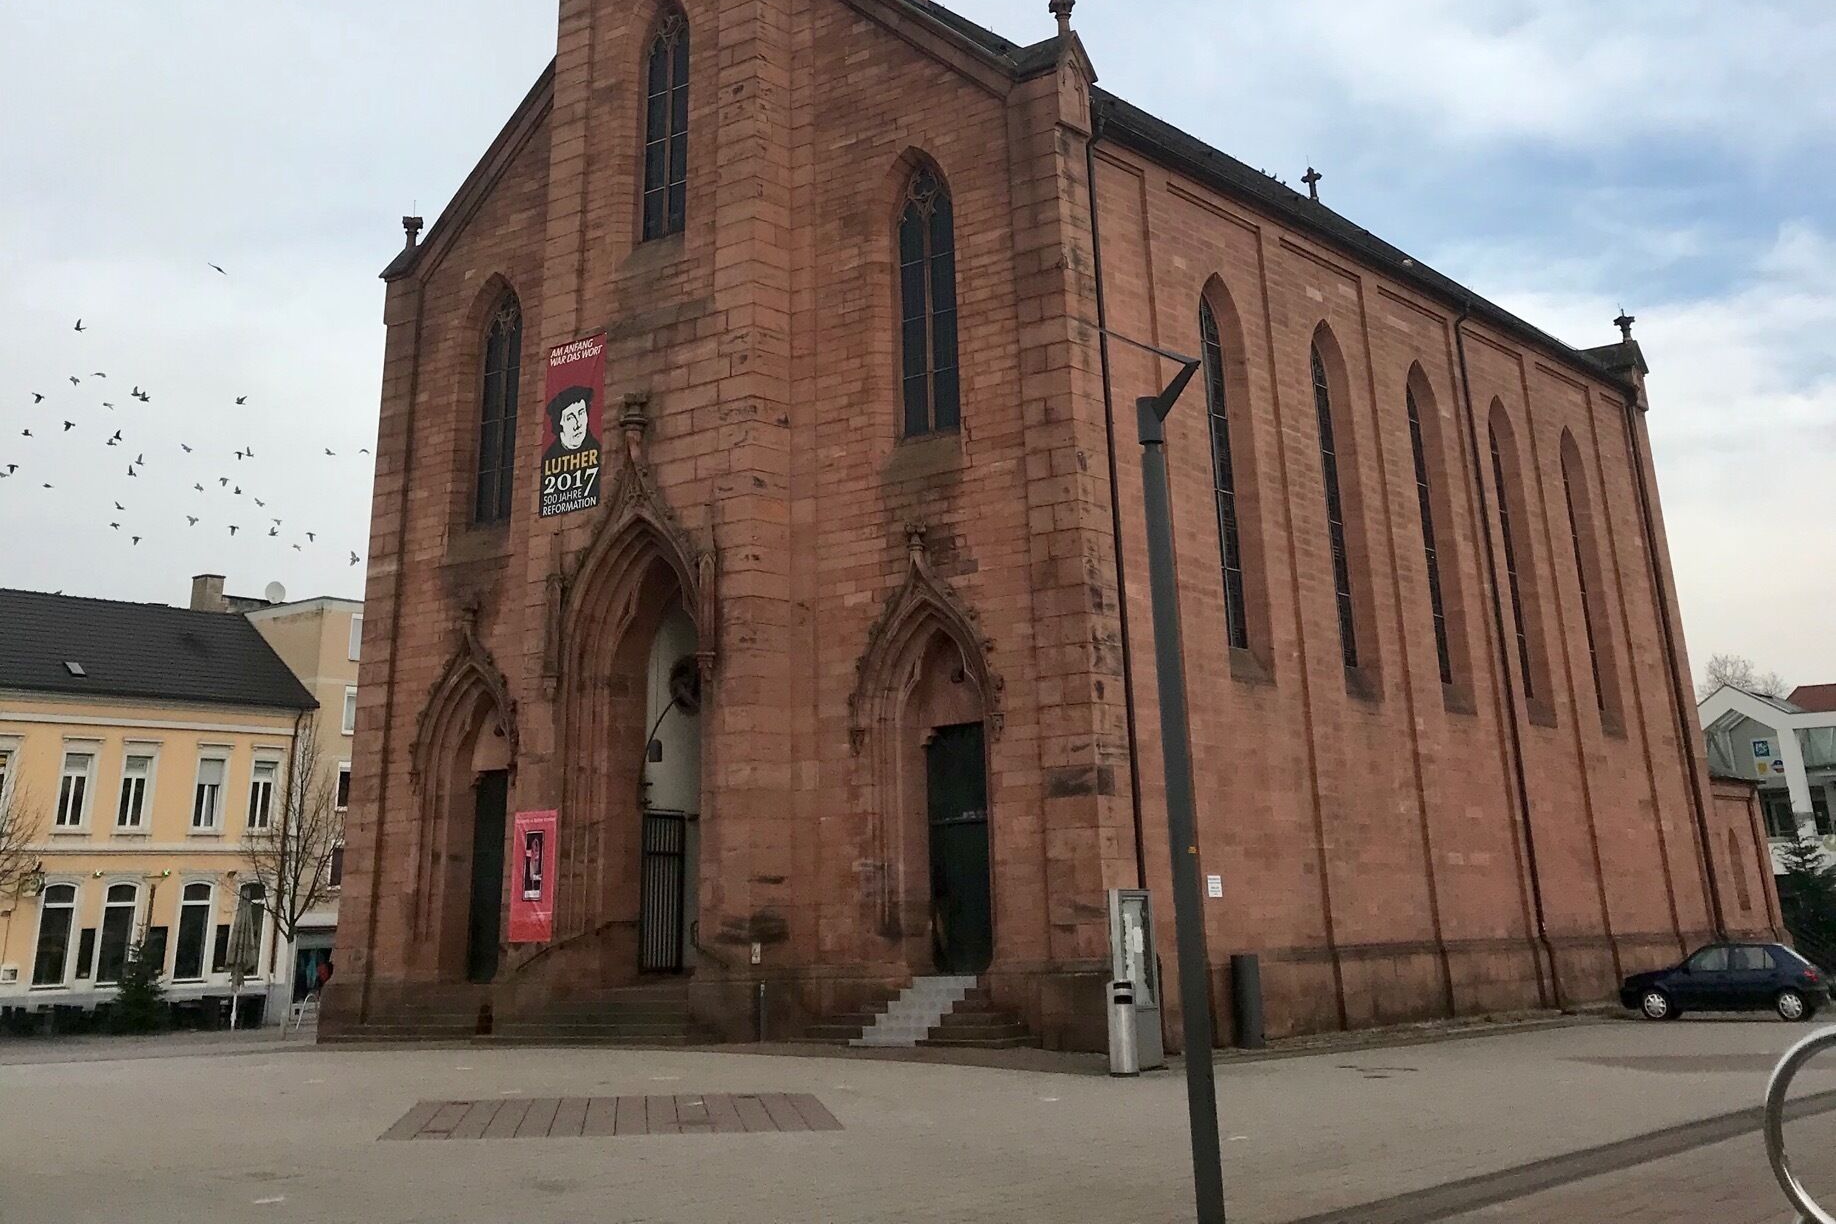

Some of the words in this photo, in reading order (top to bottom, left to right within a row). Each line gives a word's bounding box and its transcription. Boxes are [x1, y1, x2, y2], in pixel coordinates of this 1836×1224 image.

[550, 347, 563, 358] AM
[563, 338, 593, 355] ANFANG
[550, 355, 566, 367] WAR
[566, 351, 581, 363] DAS
[581, 344, 603, 359] WORT
[545, 449, 598, 476] LUTHER
[543, 467, 599, 496] 2017
[542, 496, 597, 516] REFORMATION
[543, 493, 558, 506] 500
[558, 488, 582, 503] JAHRE
